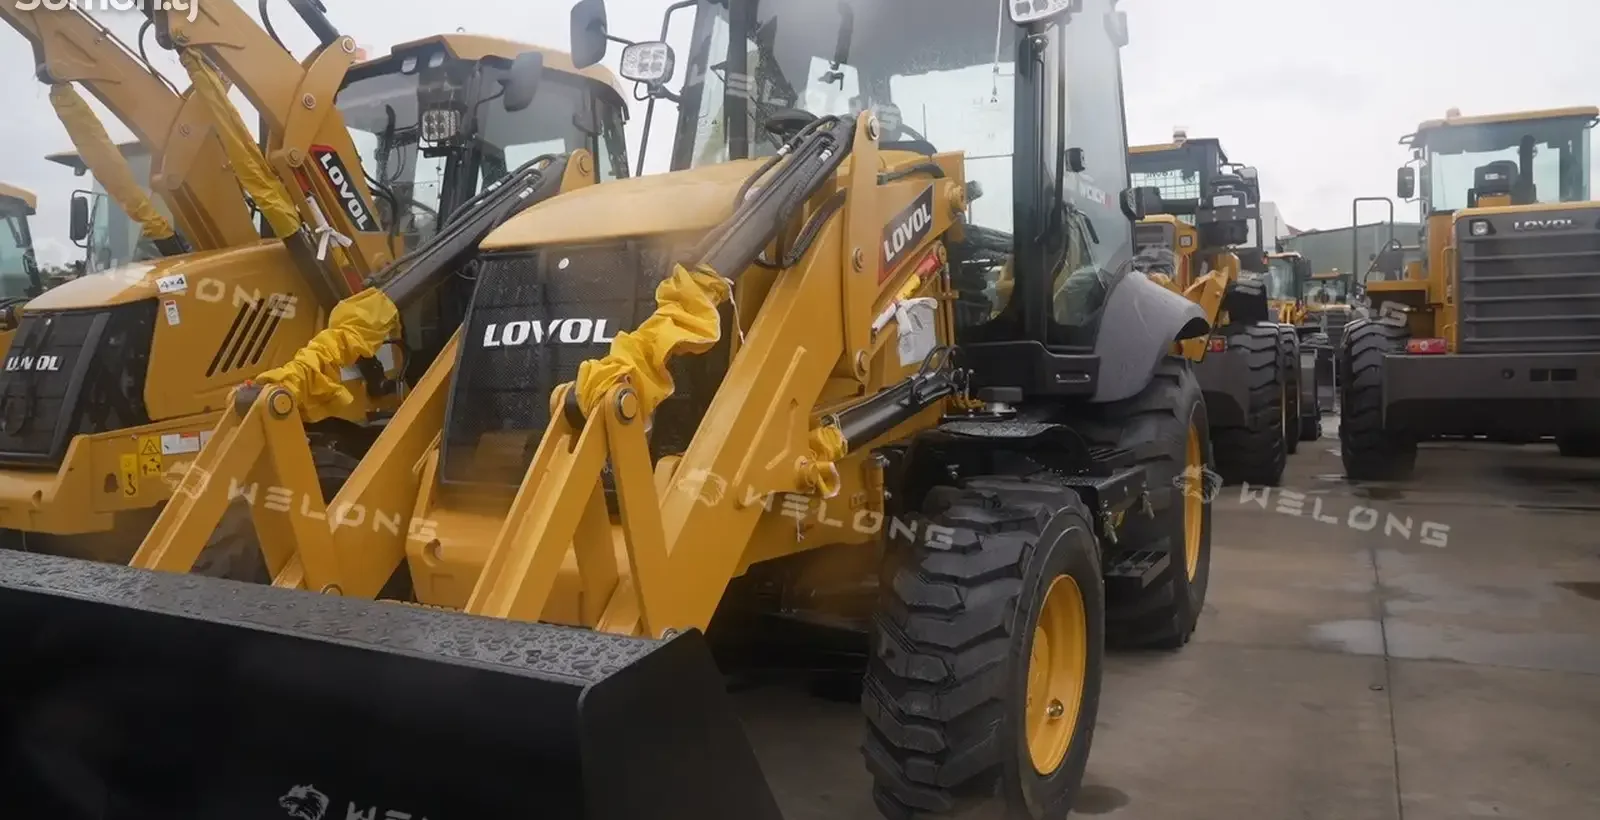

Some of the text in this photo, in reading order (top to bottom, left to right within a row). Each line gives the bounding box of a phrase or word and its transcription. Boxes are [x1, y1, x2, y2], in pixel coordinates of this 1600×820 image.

[320, 152, 369, 231] LOVOL
[883, 203, 932, 262] LOVOL
[1513, 219, 1577, 232] LOVOL
[483, 318, 615, 347] LOVOL
